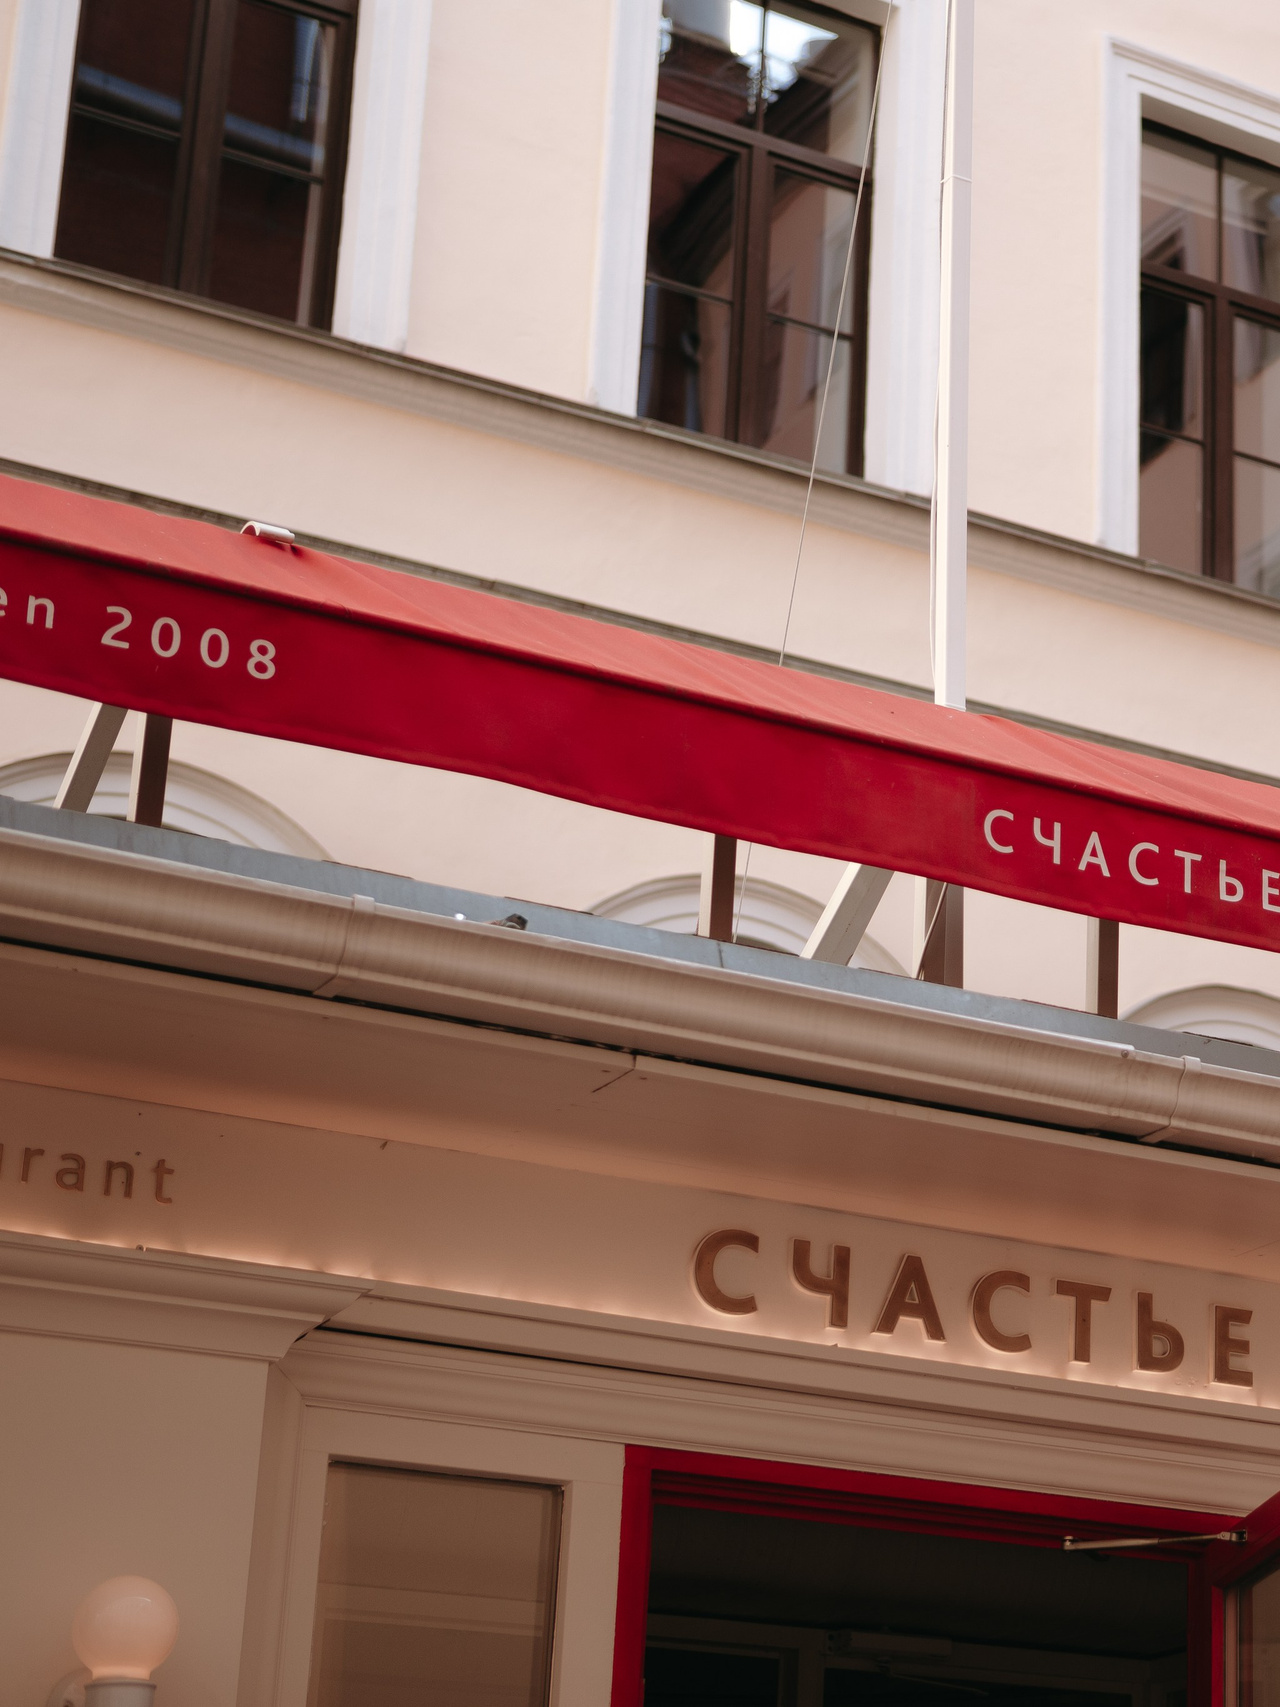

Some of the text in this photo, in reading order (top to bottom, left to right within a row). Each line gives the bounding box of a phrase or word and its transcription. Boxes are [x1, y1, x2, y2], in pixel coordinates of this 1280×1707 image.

[0, 587, 276, 681] n 2008
[0, 1143, 176, 1205] rant
[690, 1227, 1256, 1388] СЧАСТЬЕ
